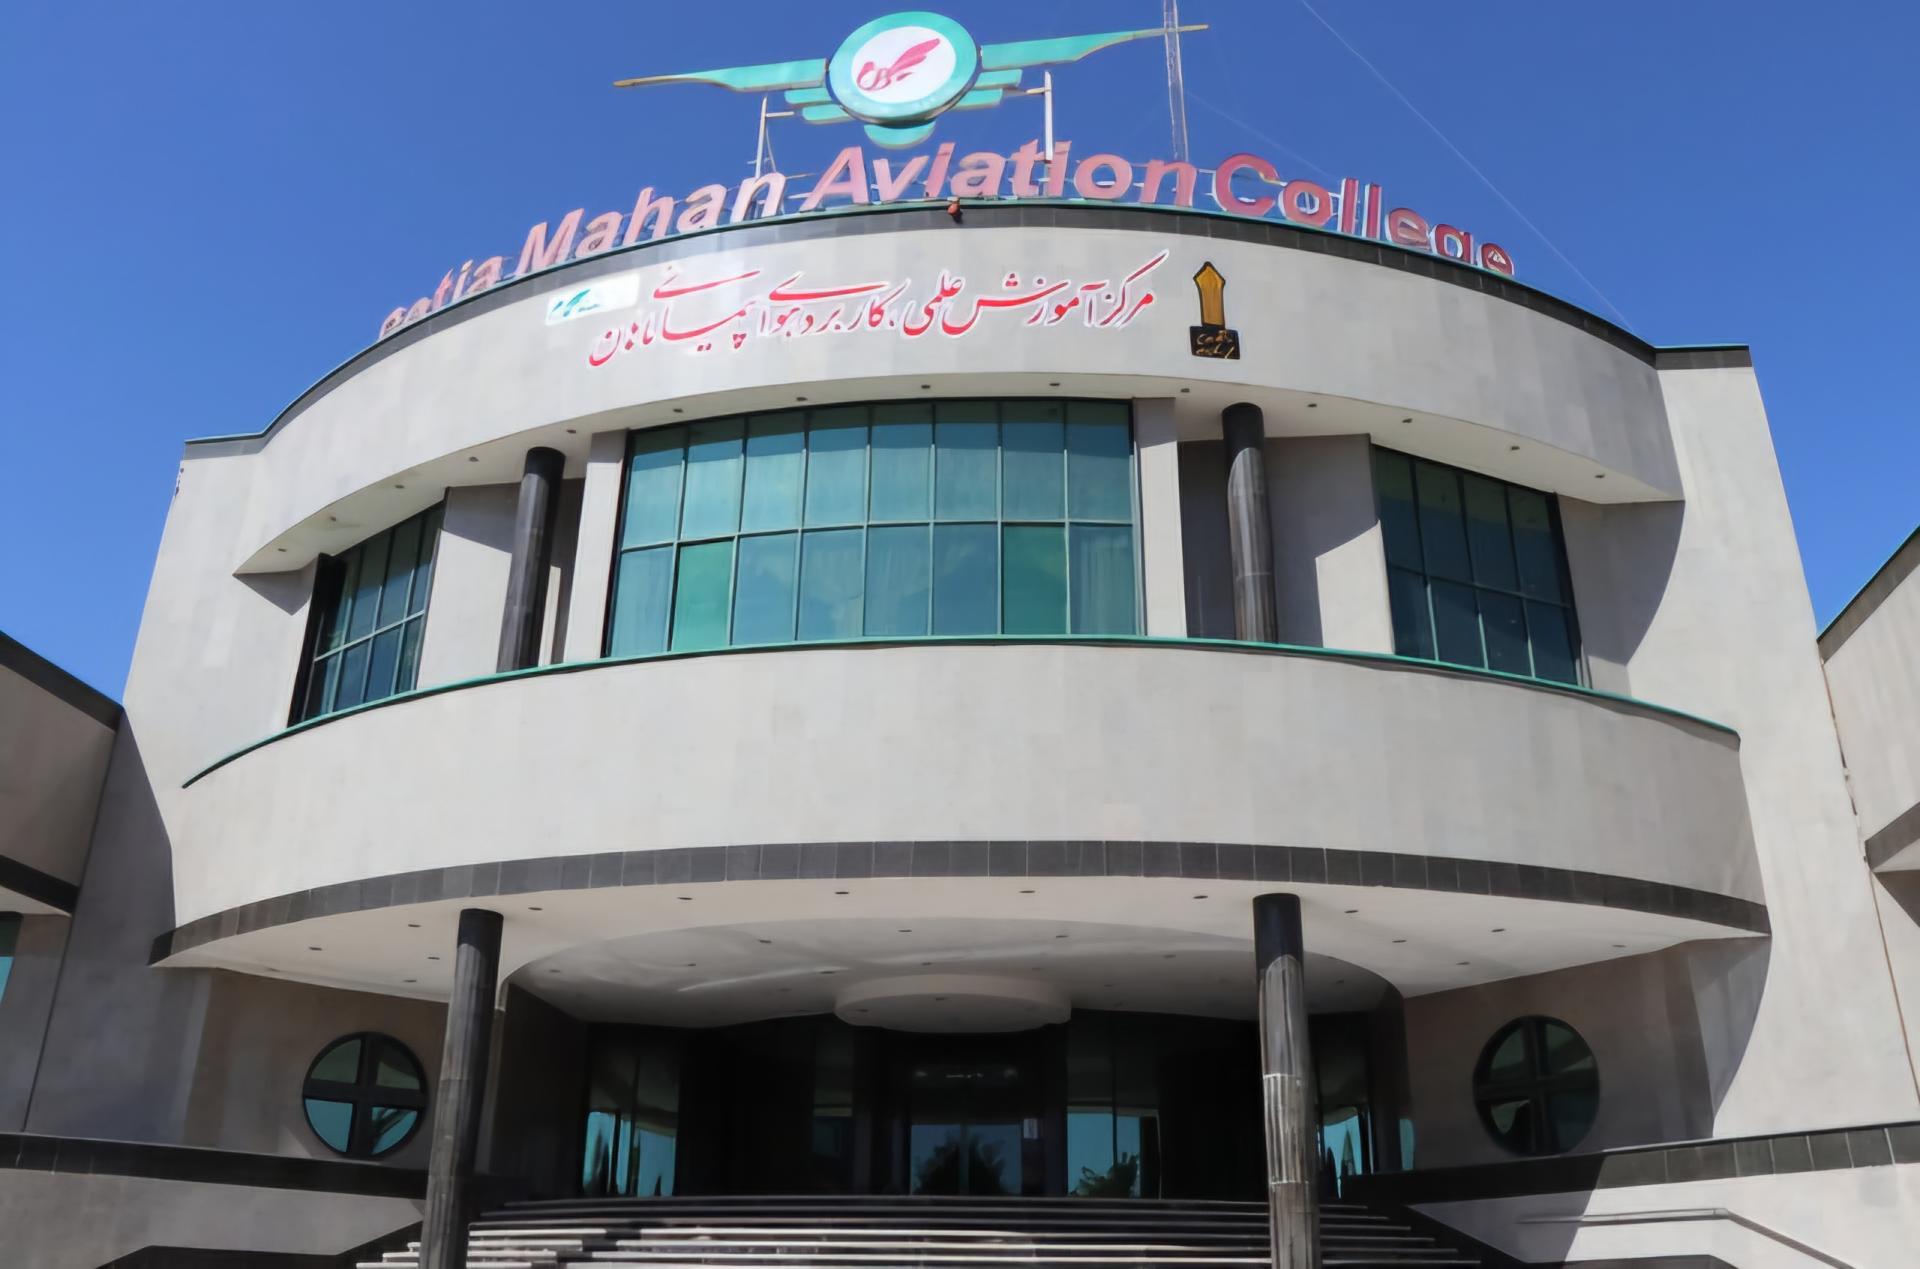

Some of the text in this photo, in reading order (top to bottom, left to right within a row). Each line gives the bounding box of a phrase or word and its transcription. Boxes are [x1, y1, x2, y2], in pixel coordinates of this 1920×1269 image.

[514, 170, 787, 276] Mahan
[801, 140, 1198, 209] Aviation
[1213, 153, 1515, 276] College
[942, 272, 1108, 336] آموزش
[1100, 250, 1170, 328] مرکز
